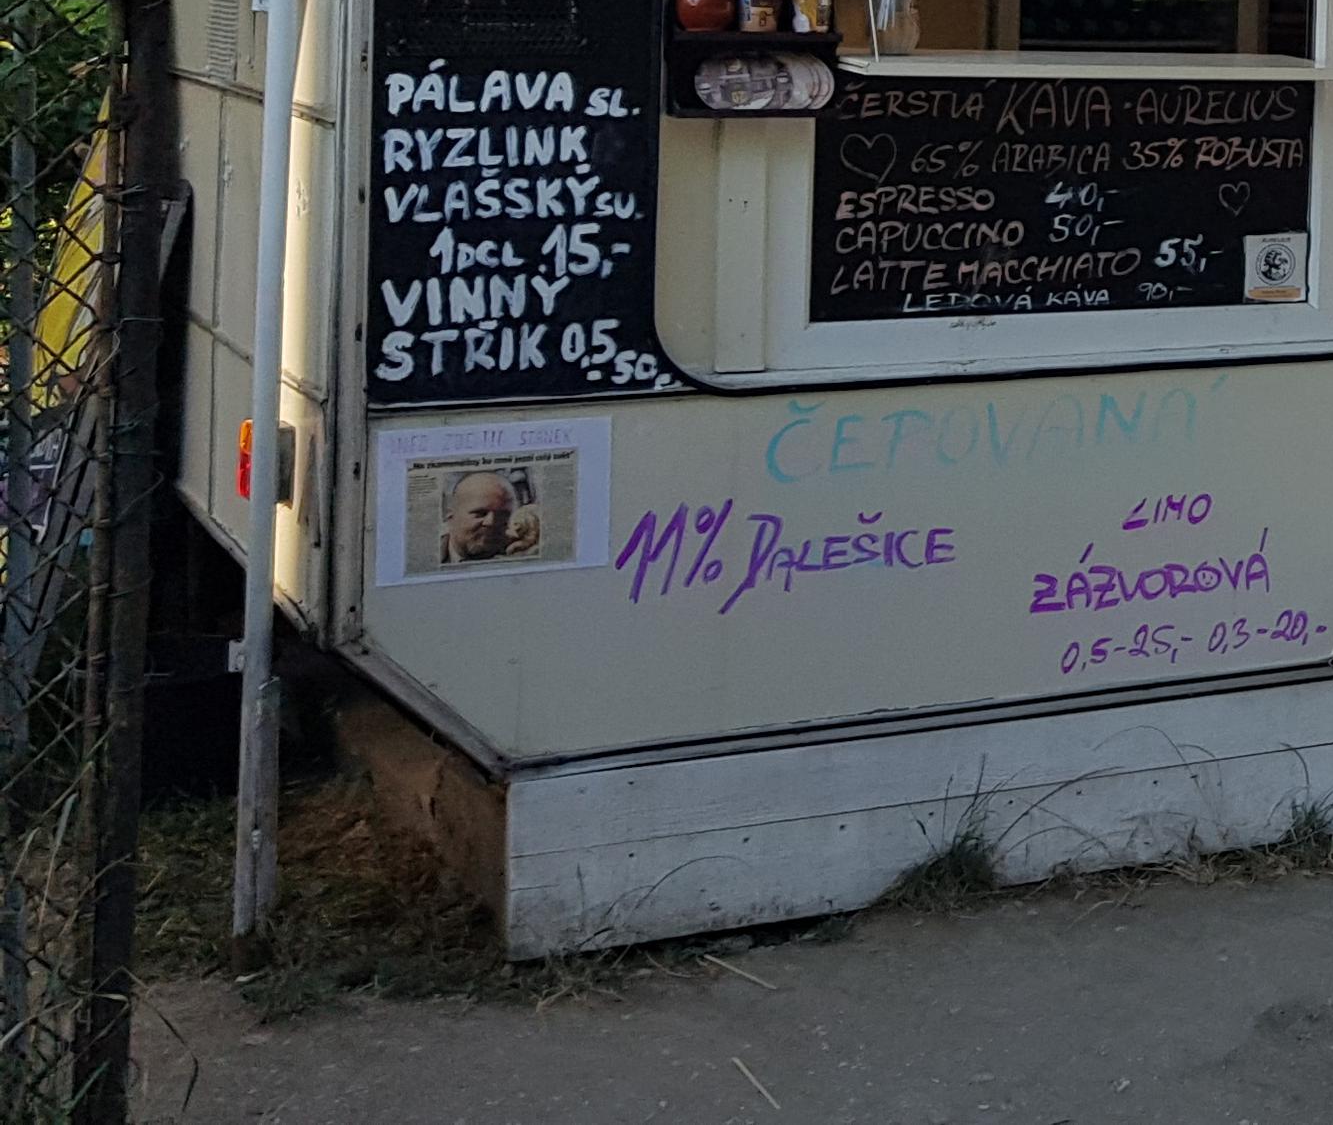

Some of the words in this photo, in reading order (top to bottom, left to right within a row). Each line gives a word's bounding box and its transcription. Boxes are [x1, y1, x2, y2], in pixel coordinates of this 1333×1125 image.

[384, 58, 575, 116] PÁLAVA
[584, 87, 641, 117] SL.
[836, 79, 997, 121] ČERSTVÁ
[996, 78, 1112, 136] KÁVA
[1136, 86, 1299, 126] AURELIUS
[381, 125, 591, 174] RYZLINK
[909, 139, 982, 179] 65%
[991, 139, 1111, 176] ARABICA
[1122, 137, 1189, 172] 35%
[1194, 135, 1306, 172] ROBUSTA
[383, 164, 601, 223] VLAŠSKÝ
[834, 184, 996, 221] ESPRESSO
[834, 219, 1026, 255] CAPUCCINO
[829, 255, 949, 295] LATTE
[956, 247, 1143, 289] MACCHIATO
[901, 283, 1034, 313] LEDOVÁ
[1045, 282, 1111, 308] KÁVA
[373, 319, 549, 382] STŘIK
[1121, 492, 1214, 531] LIMO
[615, 498, 734, 605] 11%
[718, 511, 957, 615] DALEŠICE
[1029, 527, 1272, 614] ZÁZVOROVÁ
